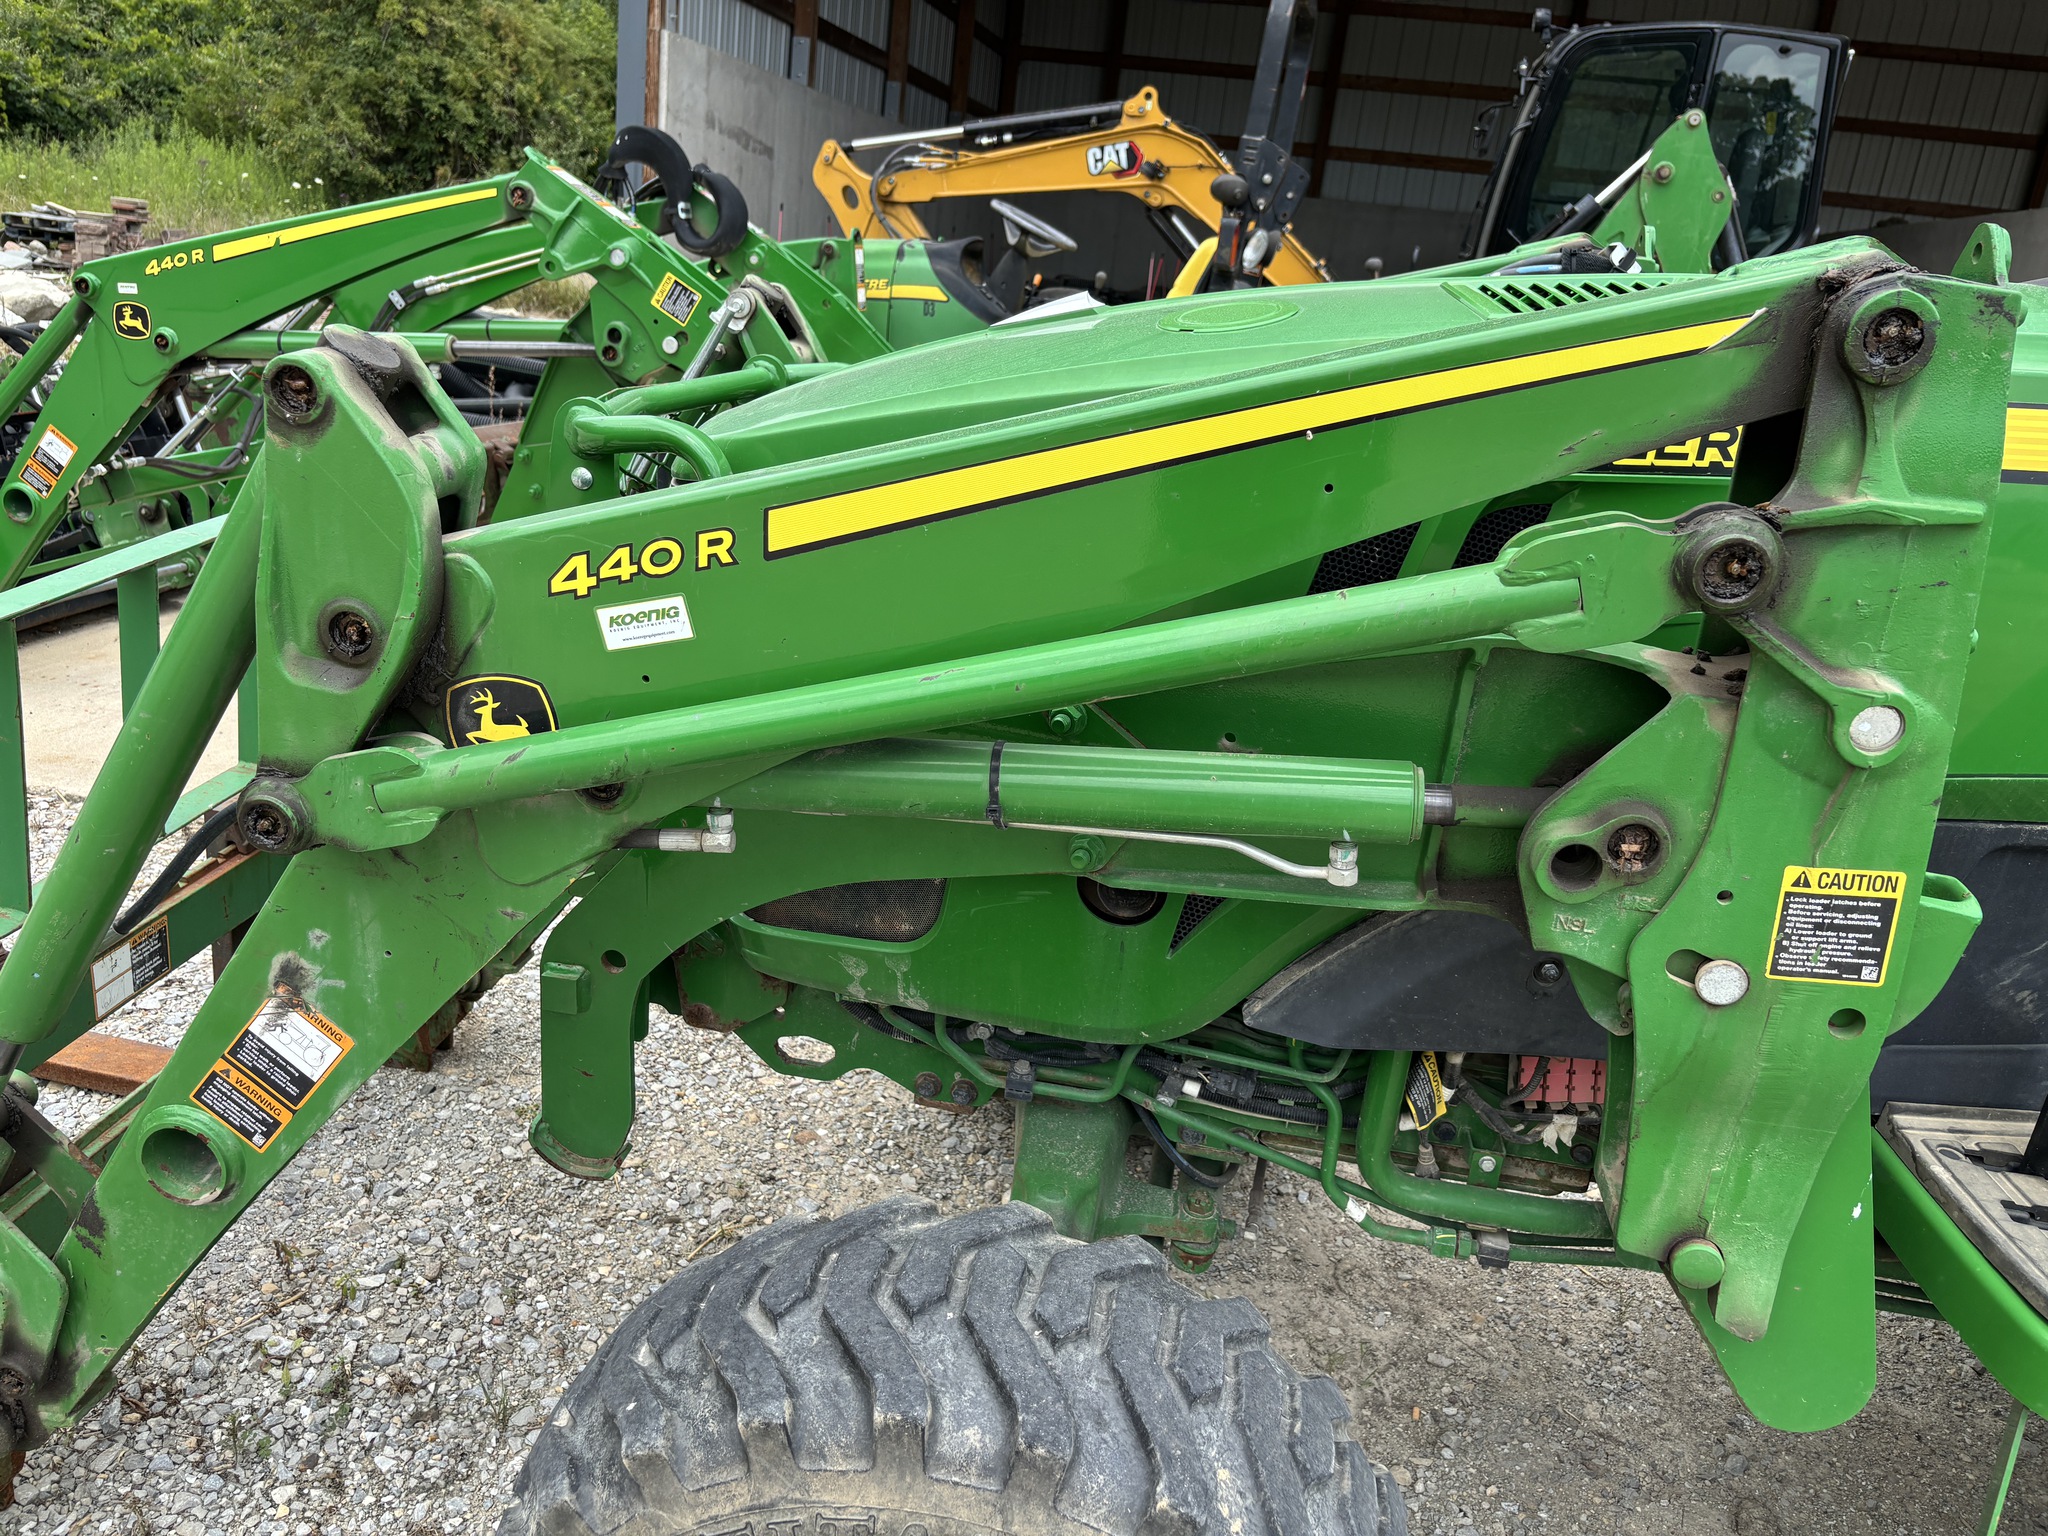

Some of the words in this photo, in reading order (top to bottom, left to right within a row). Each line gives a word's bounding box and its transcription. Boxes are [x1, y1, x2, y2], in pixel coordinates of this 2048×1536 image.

[1086, 141, 1130, 176] CAT
[145, 252, 188, 276] 440
[191, 249, 204, 264] R
[548, 537, 684, 600] 440
[695, 527, 739, 571] R
[1818, 872, 1899, 893] CAUTION
[1786, 915, 1822, 923] equipment
[1832, 918, 1881, 927] disconnecting
[1821, 949, 1853, 957] pressure.
[235, 1077, 282, 1118] WARNING
[1428, 1062, 1442, 1104] CAUTION
